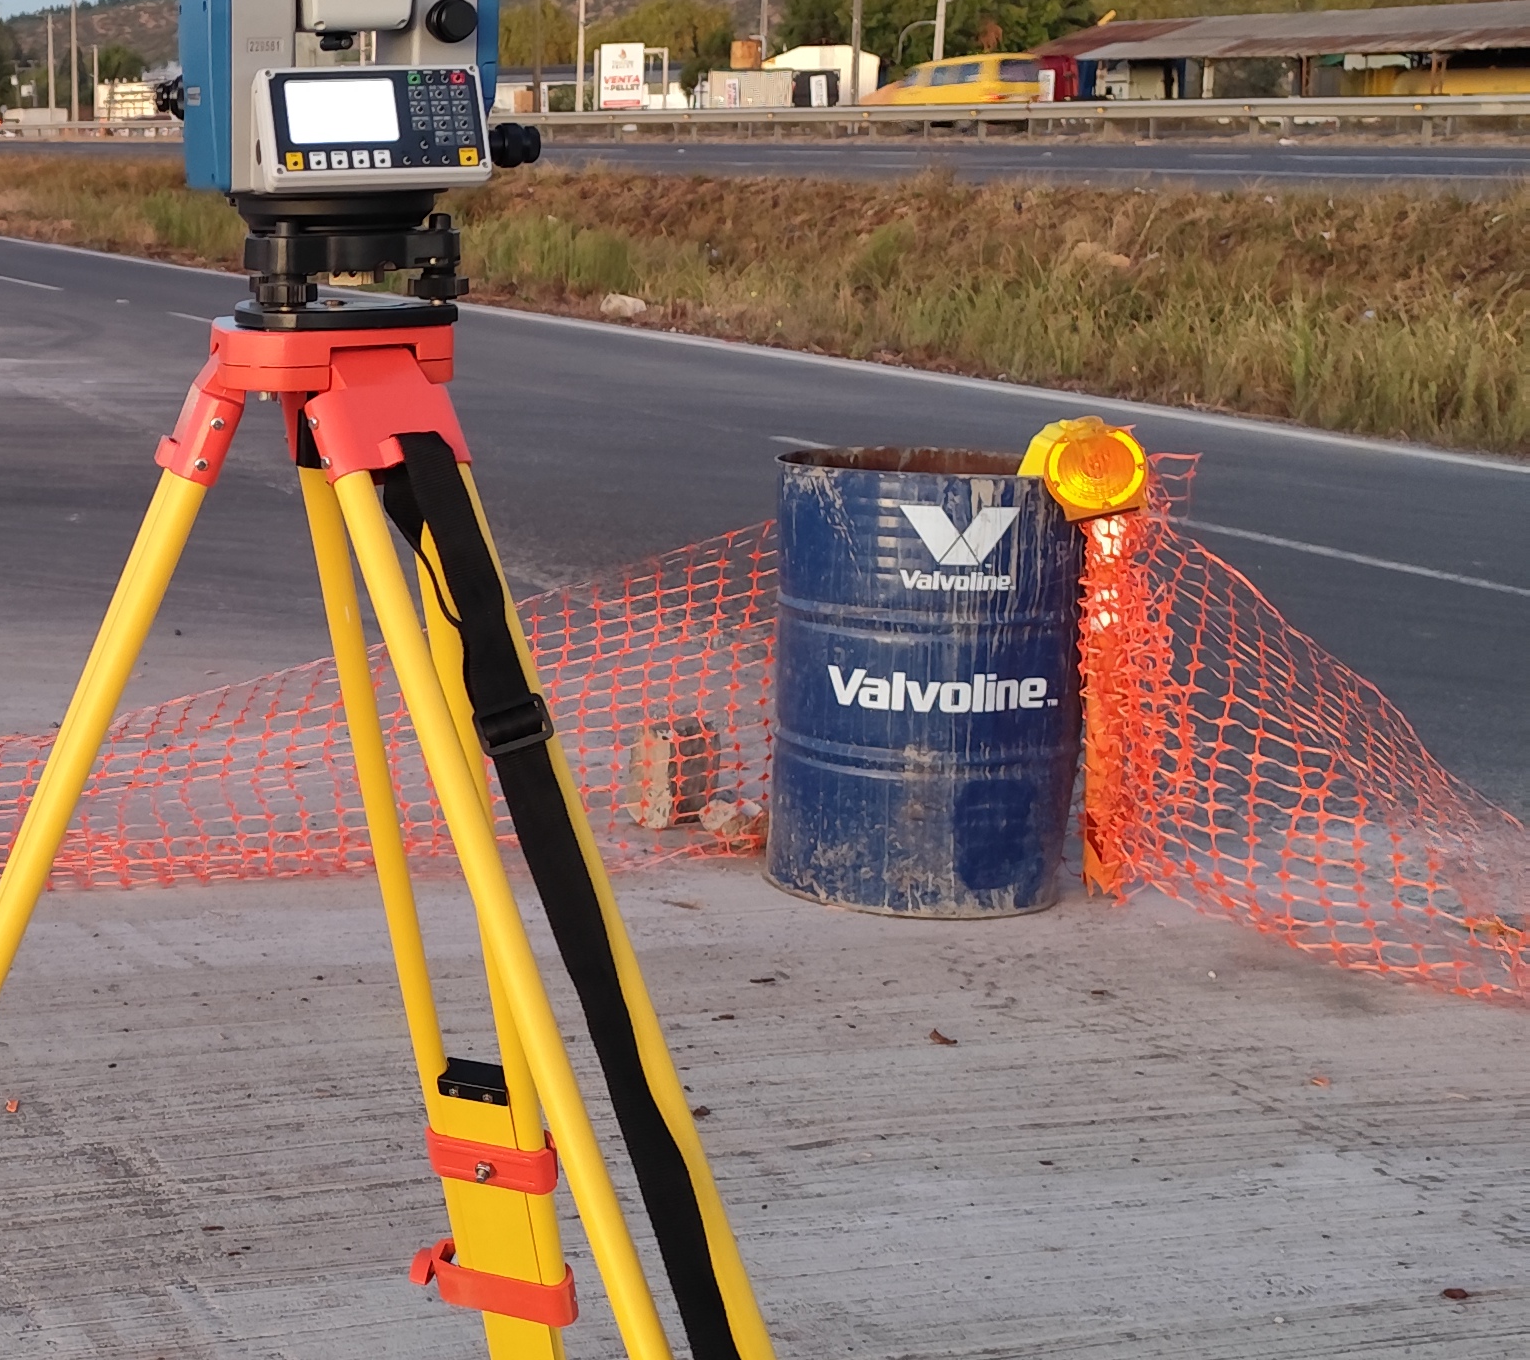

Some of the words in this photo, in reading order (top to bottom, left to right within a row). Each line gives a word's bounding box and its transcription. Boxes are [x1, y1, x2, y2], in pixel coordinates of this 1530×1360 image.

[603, 74, 640, 84] VENTA
[610, 83, 641, 91] PELLET
[899, 569, 1013, 592] Valvoline
[827, 664, 1048, 713] Valvoline
